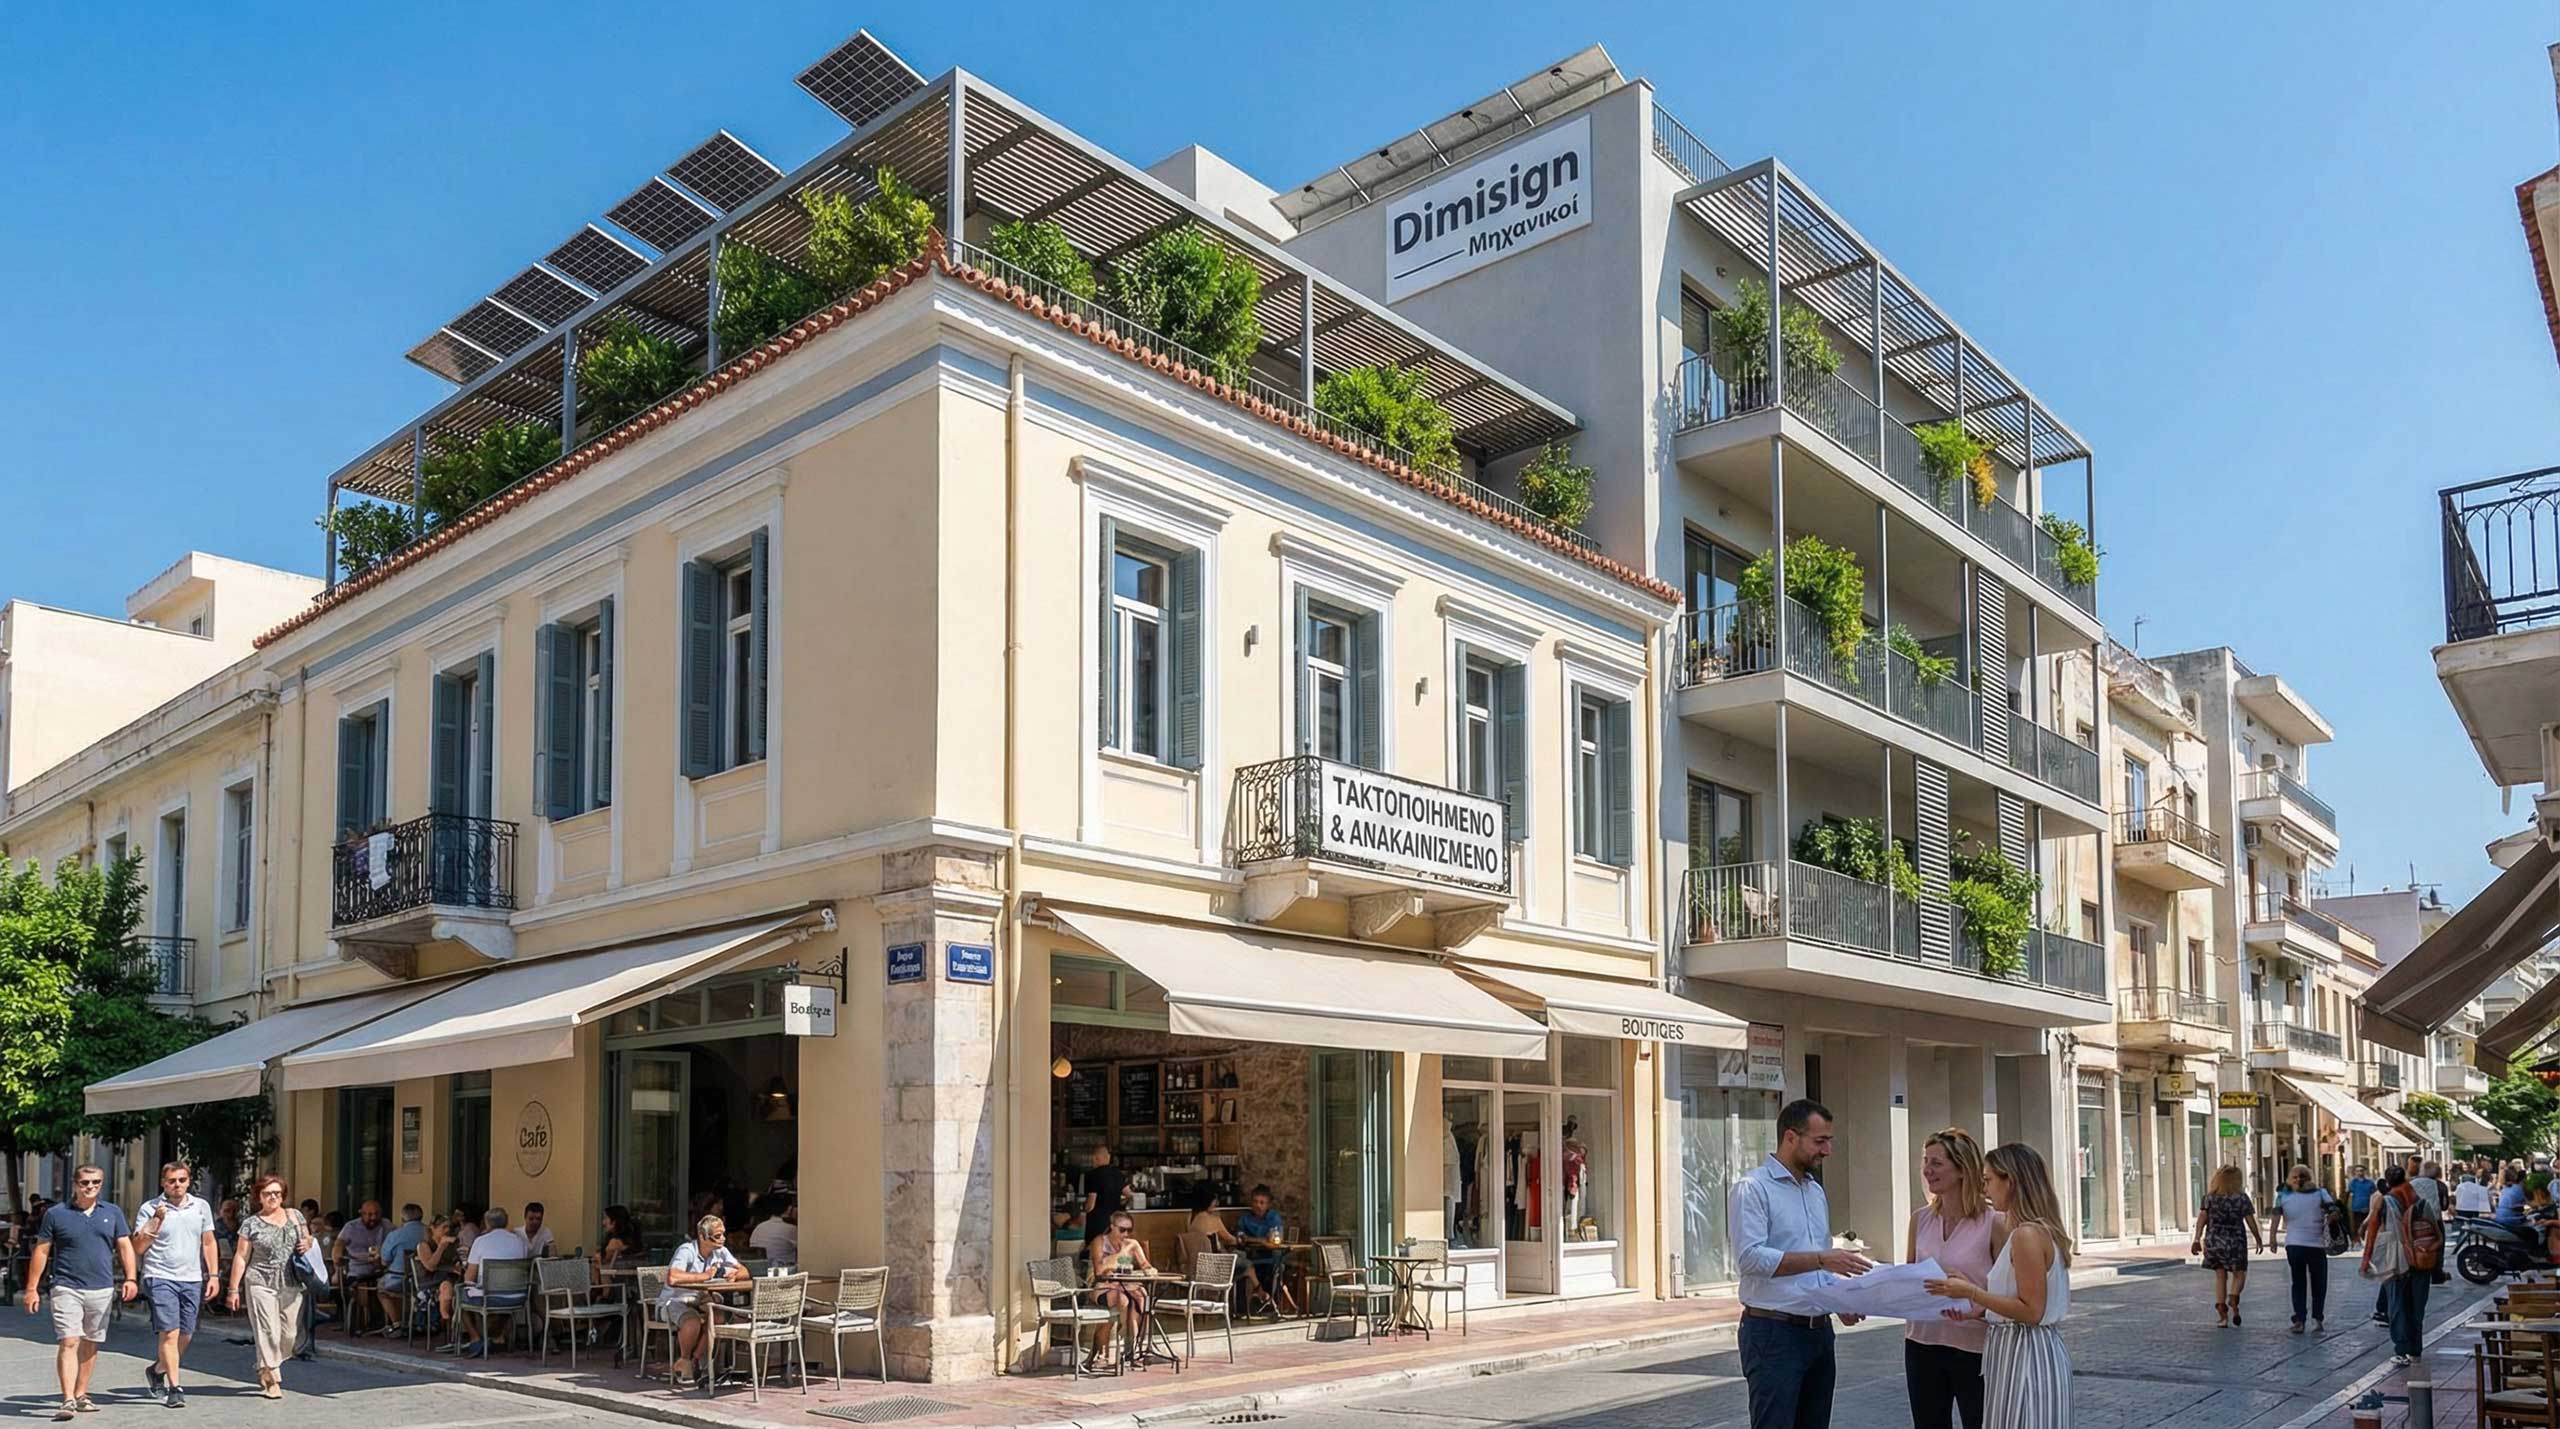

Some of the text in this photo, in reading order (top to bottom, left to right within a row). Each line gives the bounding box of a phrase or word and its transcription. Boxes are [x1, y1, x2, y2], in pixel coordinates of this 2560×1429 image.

[1394, 150, 1579, 255] Dimisign
[1469, 193, 1579, 257] Μηχανικοί
[1332, 775, 1495, 838] ΤΑΚΤΟΠΟΙΗΜΕΝΟ
[1330, 814, 1498, 874] & ΑΝΑΚΑΙΝΙΣΜΕΝΟ
[519, 1125, 548, 1148] Café
